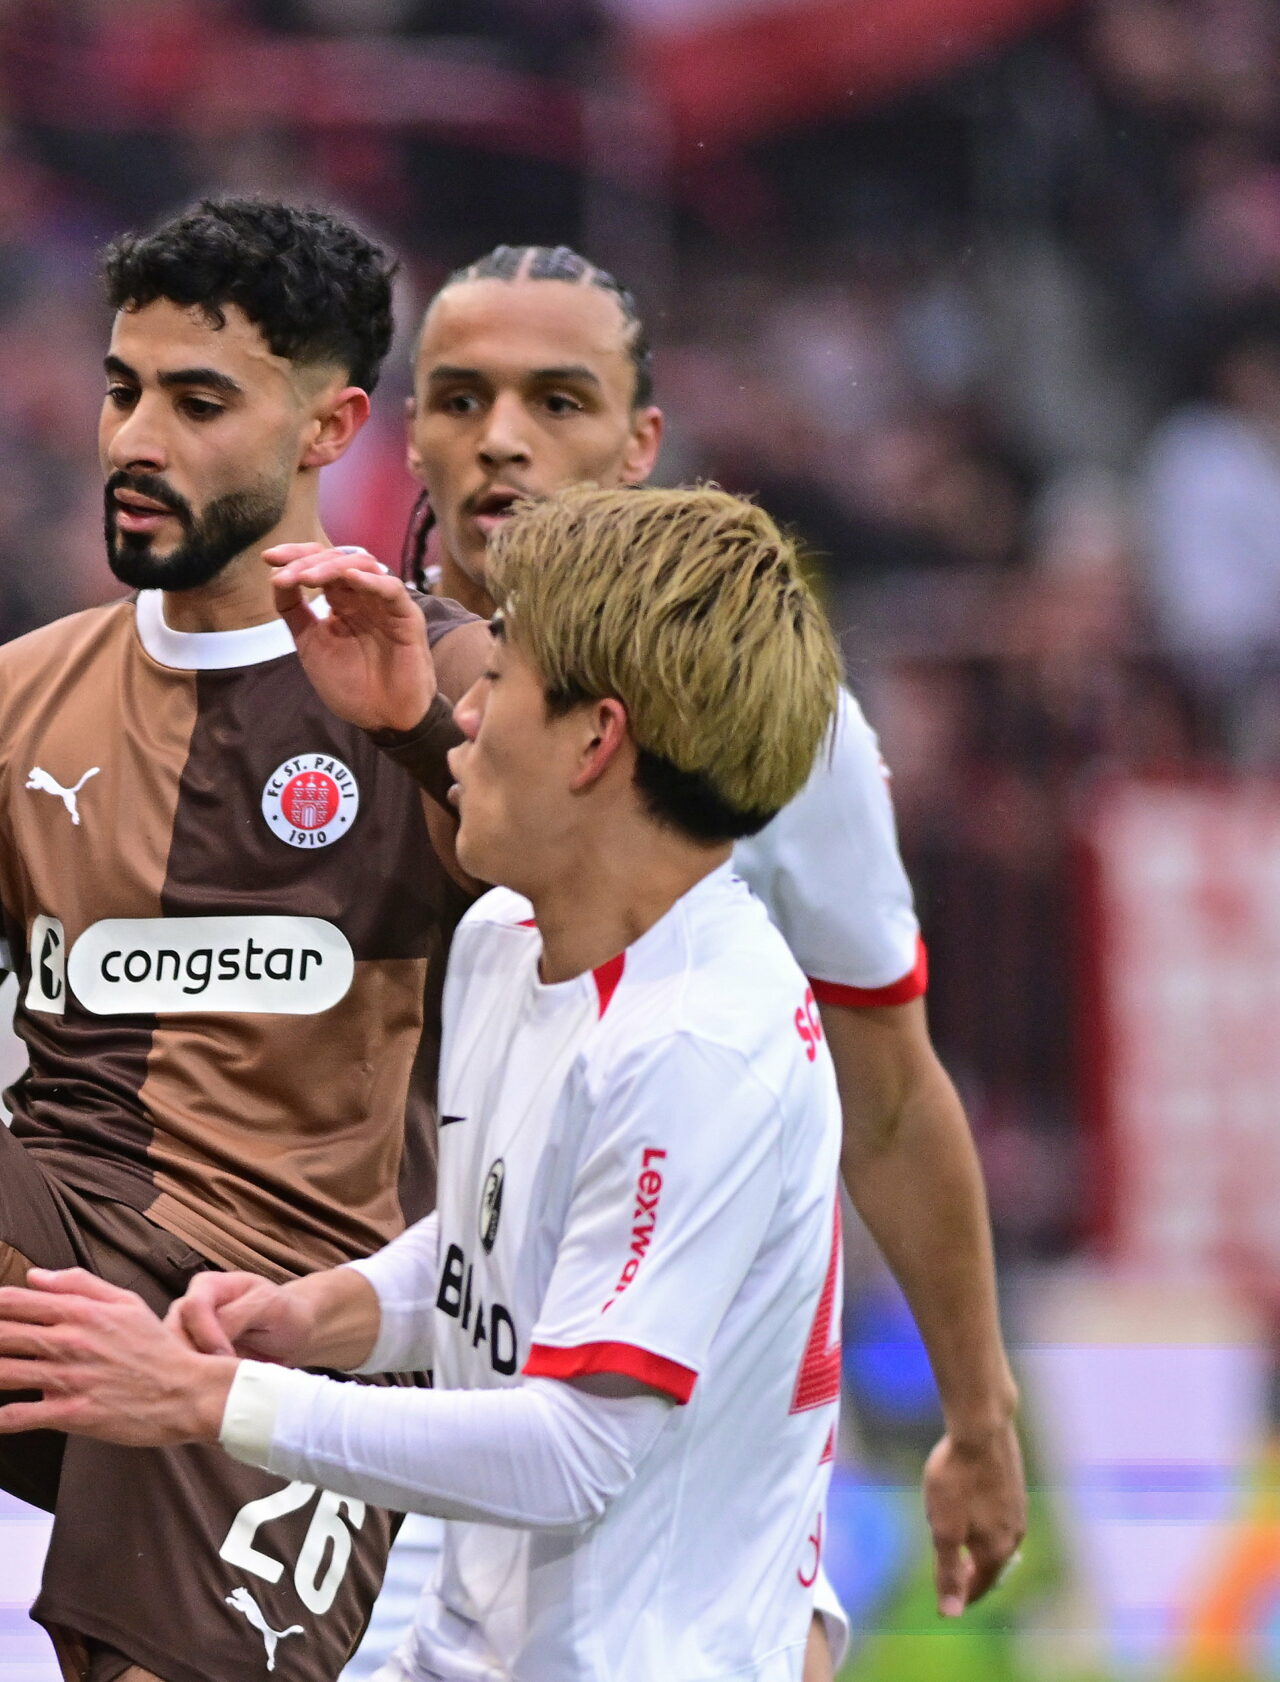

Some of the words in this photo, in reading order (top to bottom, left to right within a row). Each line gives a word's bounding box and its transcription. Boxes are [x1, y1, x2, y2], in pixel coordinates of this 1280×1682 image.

[266, 777, 285, 798] FC
[284, 758, 308, 778] ST.
[314, 756, 355, 799] PAULI
[288, 828, 327, 846] 1910
[101, 937, 323, 995] congstar
[218, 1479, 367, 1615] 26
